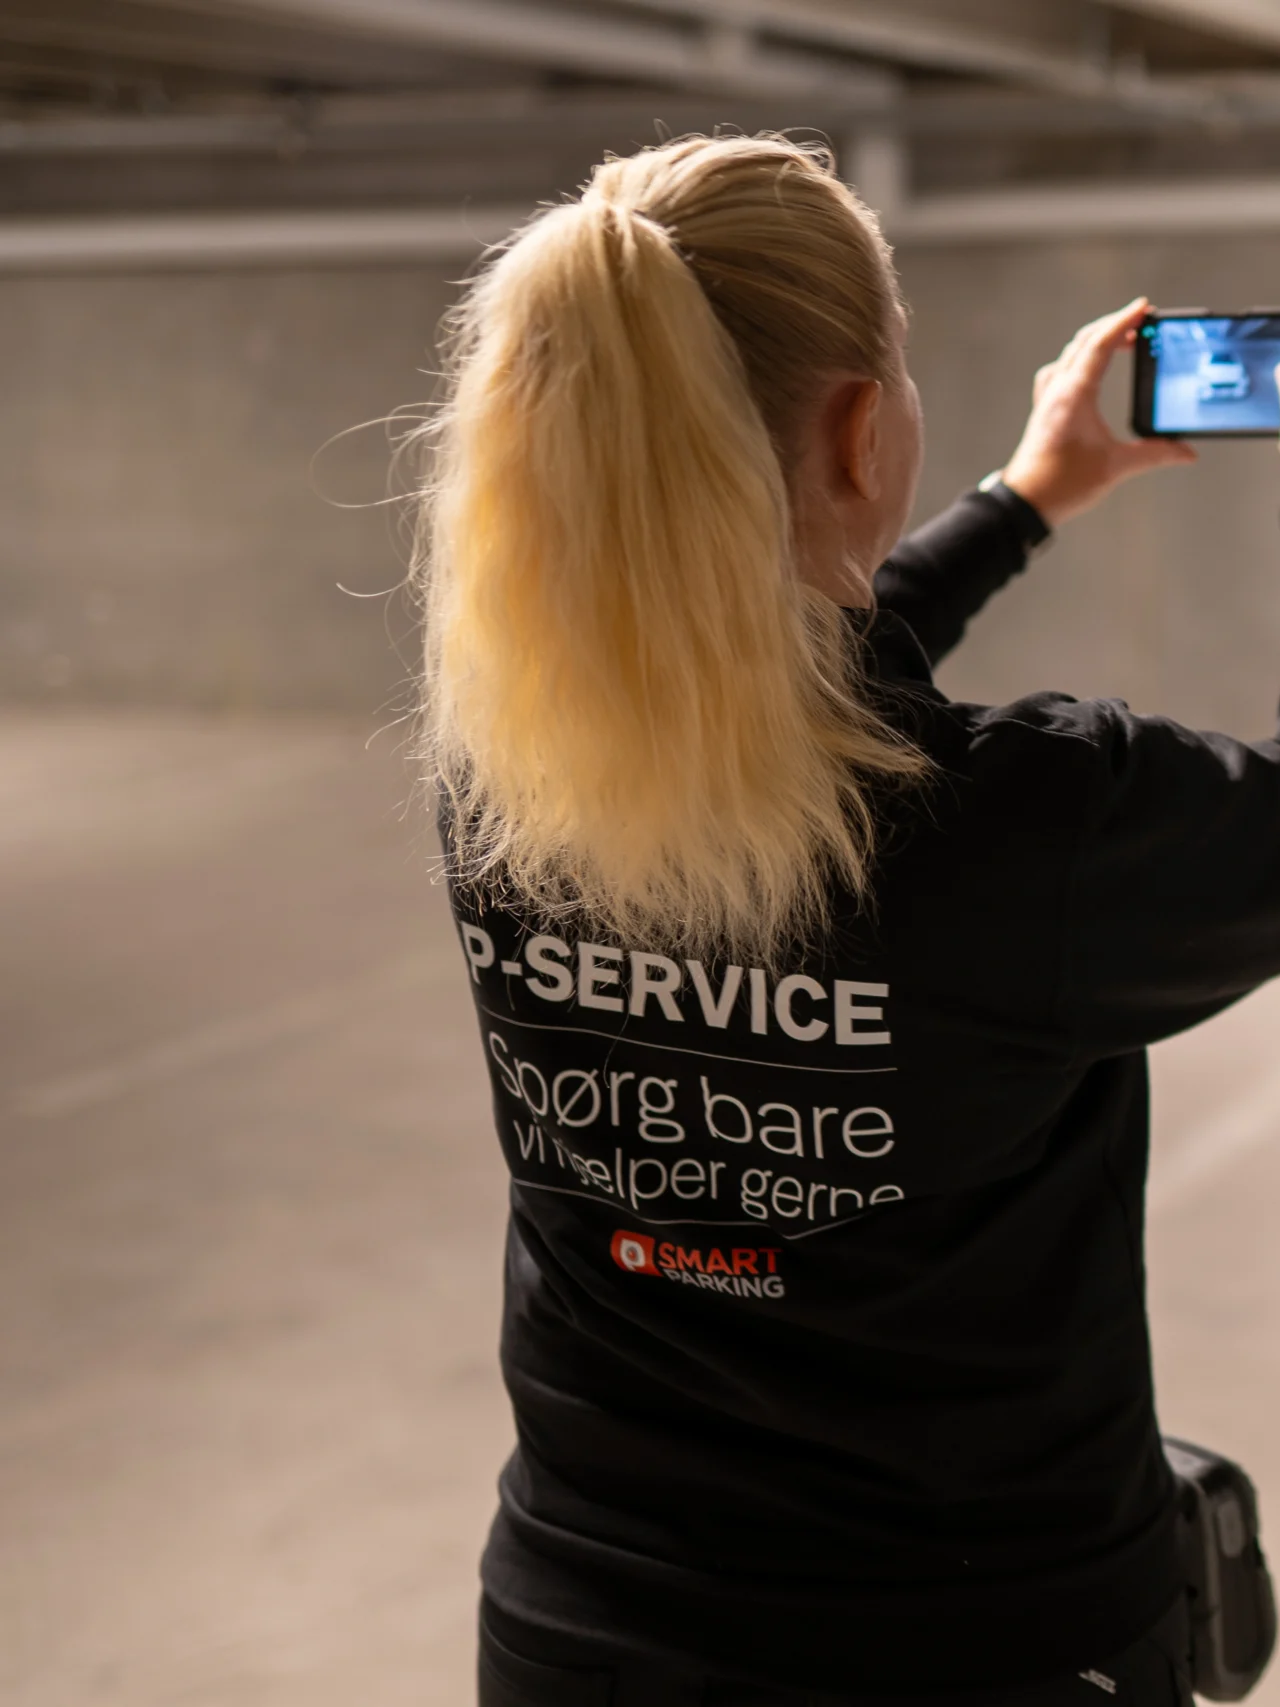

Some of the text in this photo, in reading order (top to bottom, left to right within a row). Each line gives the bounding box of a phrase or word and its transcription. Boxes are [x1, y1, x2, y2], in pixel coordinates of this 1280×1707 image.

[460, 920, 892, 1046] P-SERVICE
[489, 1031, 895, 1158] Spørg bare
[513, 1117, 546, 1165] vi
[740, 1167, 905, 1221] gerne
[657, 1241, 783, 1276] SMART
[662, 1267, 786, 1299] PARKING
